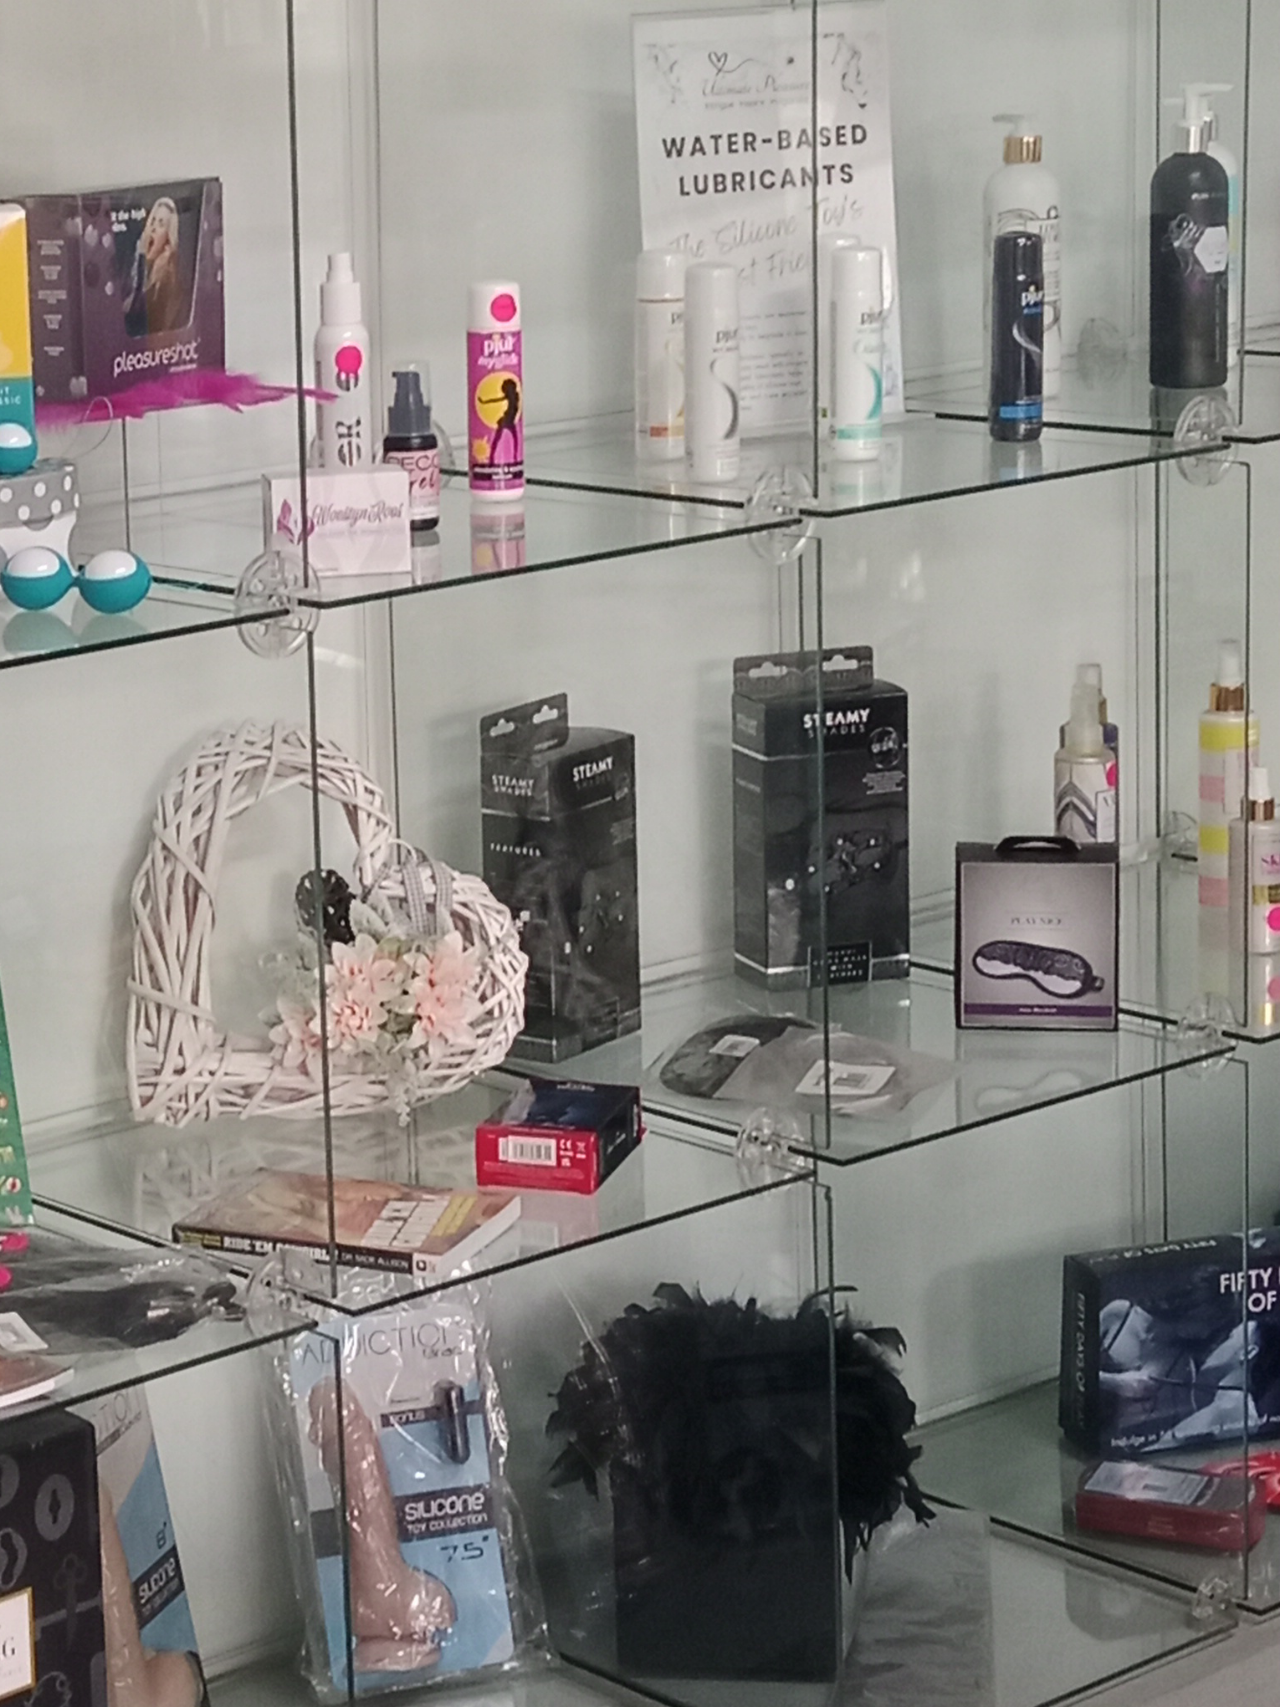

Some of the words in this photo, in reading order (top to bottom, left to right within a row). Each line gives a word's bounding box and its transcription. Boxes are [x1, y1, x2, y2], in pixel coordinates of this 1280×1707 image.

[662, 124, 868, 158] WATER-BASED
[679, 163, 854, 197] LUBRICANTS
[484, 334, 515, 356] pjur
[114, 340, 199, 378] pleasureshot
[803, 708, 870, 729] STEAMY
[573, 756, 614, 782] STEAMY
[492, 774, 534, 789] STEAMY
[494, 785, 533, 797] SHADES
[223, 1236, 251, 1251] RIDE
[1220, 1267, 1273, 1294] FIFTY
[1248, 1290, 1277, 1313] OF
